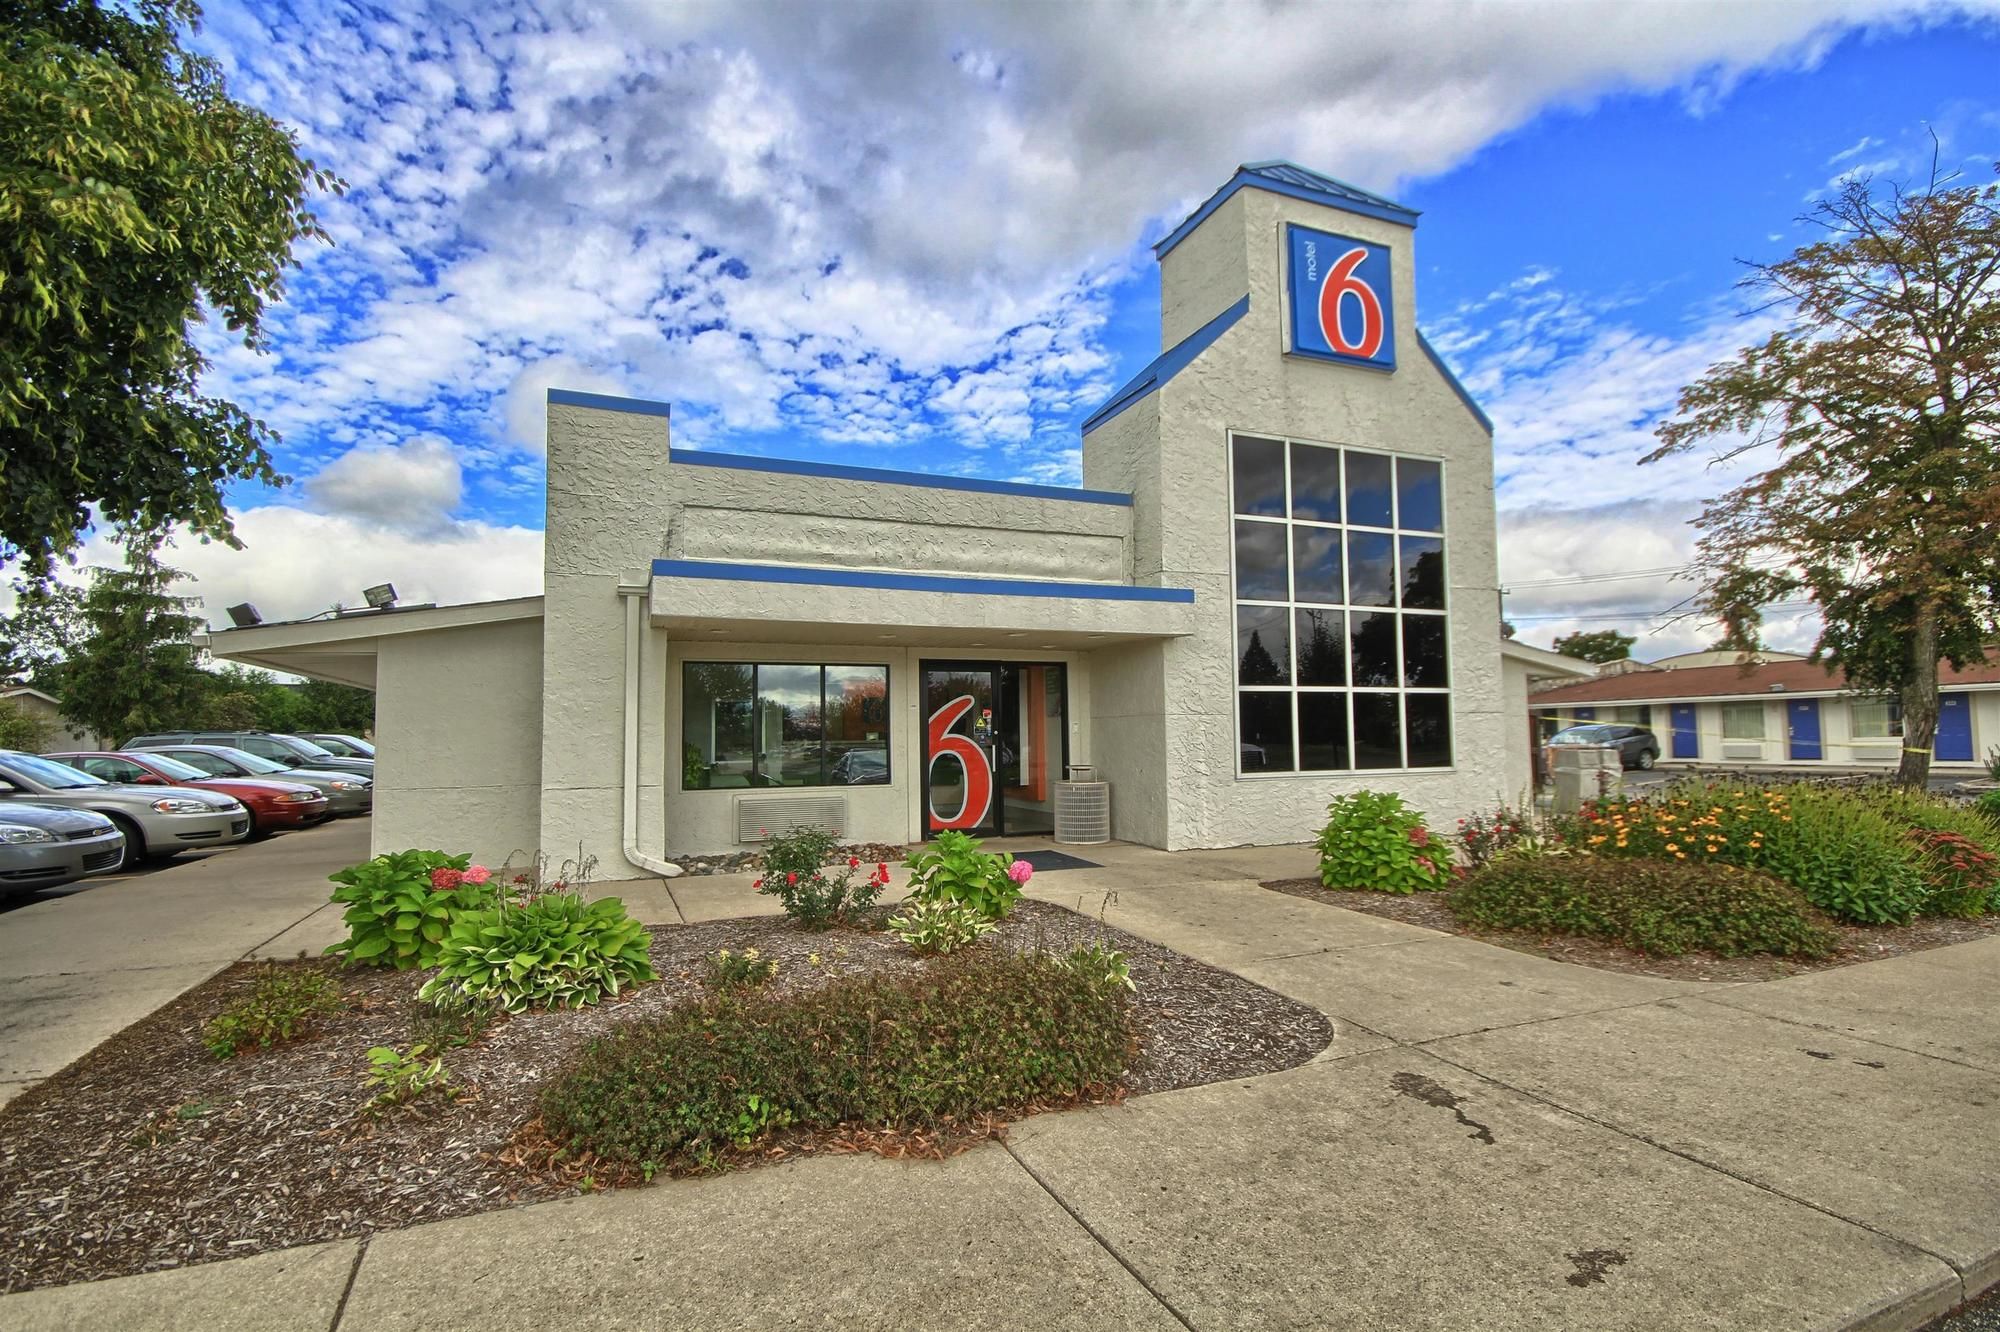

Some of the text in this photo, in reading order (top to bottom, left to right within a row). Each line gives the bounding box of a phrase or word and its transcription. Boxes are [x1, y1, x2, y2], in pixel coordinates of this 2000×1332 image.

[1304, 240, 1317, 281] motel
[1319, 248, 1384, 359] 6
[929, 695, 993, 829] 6
